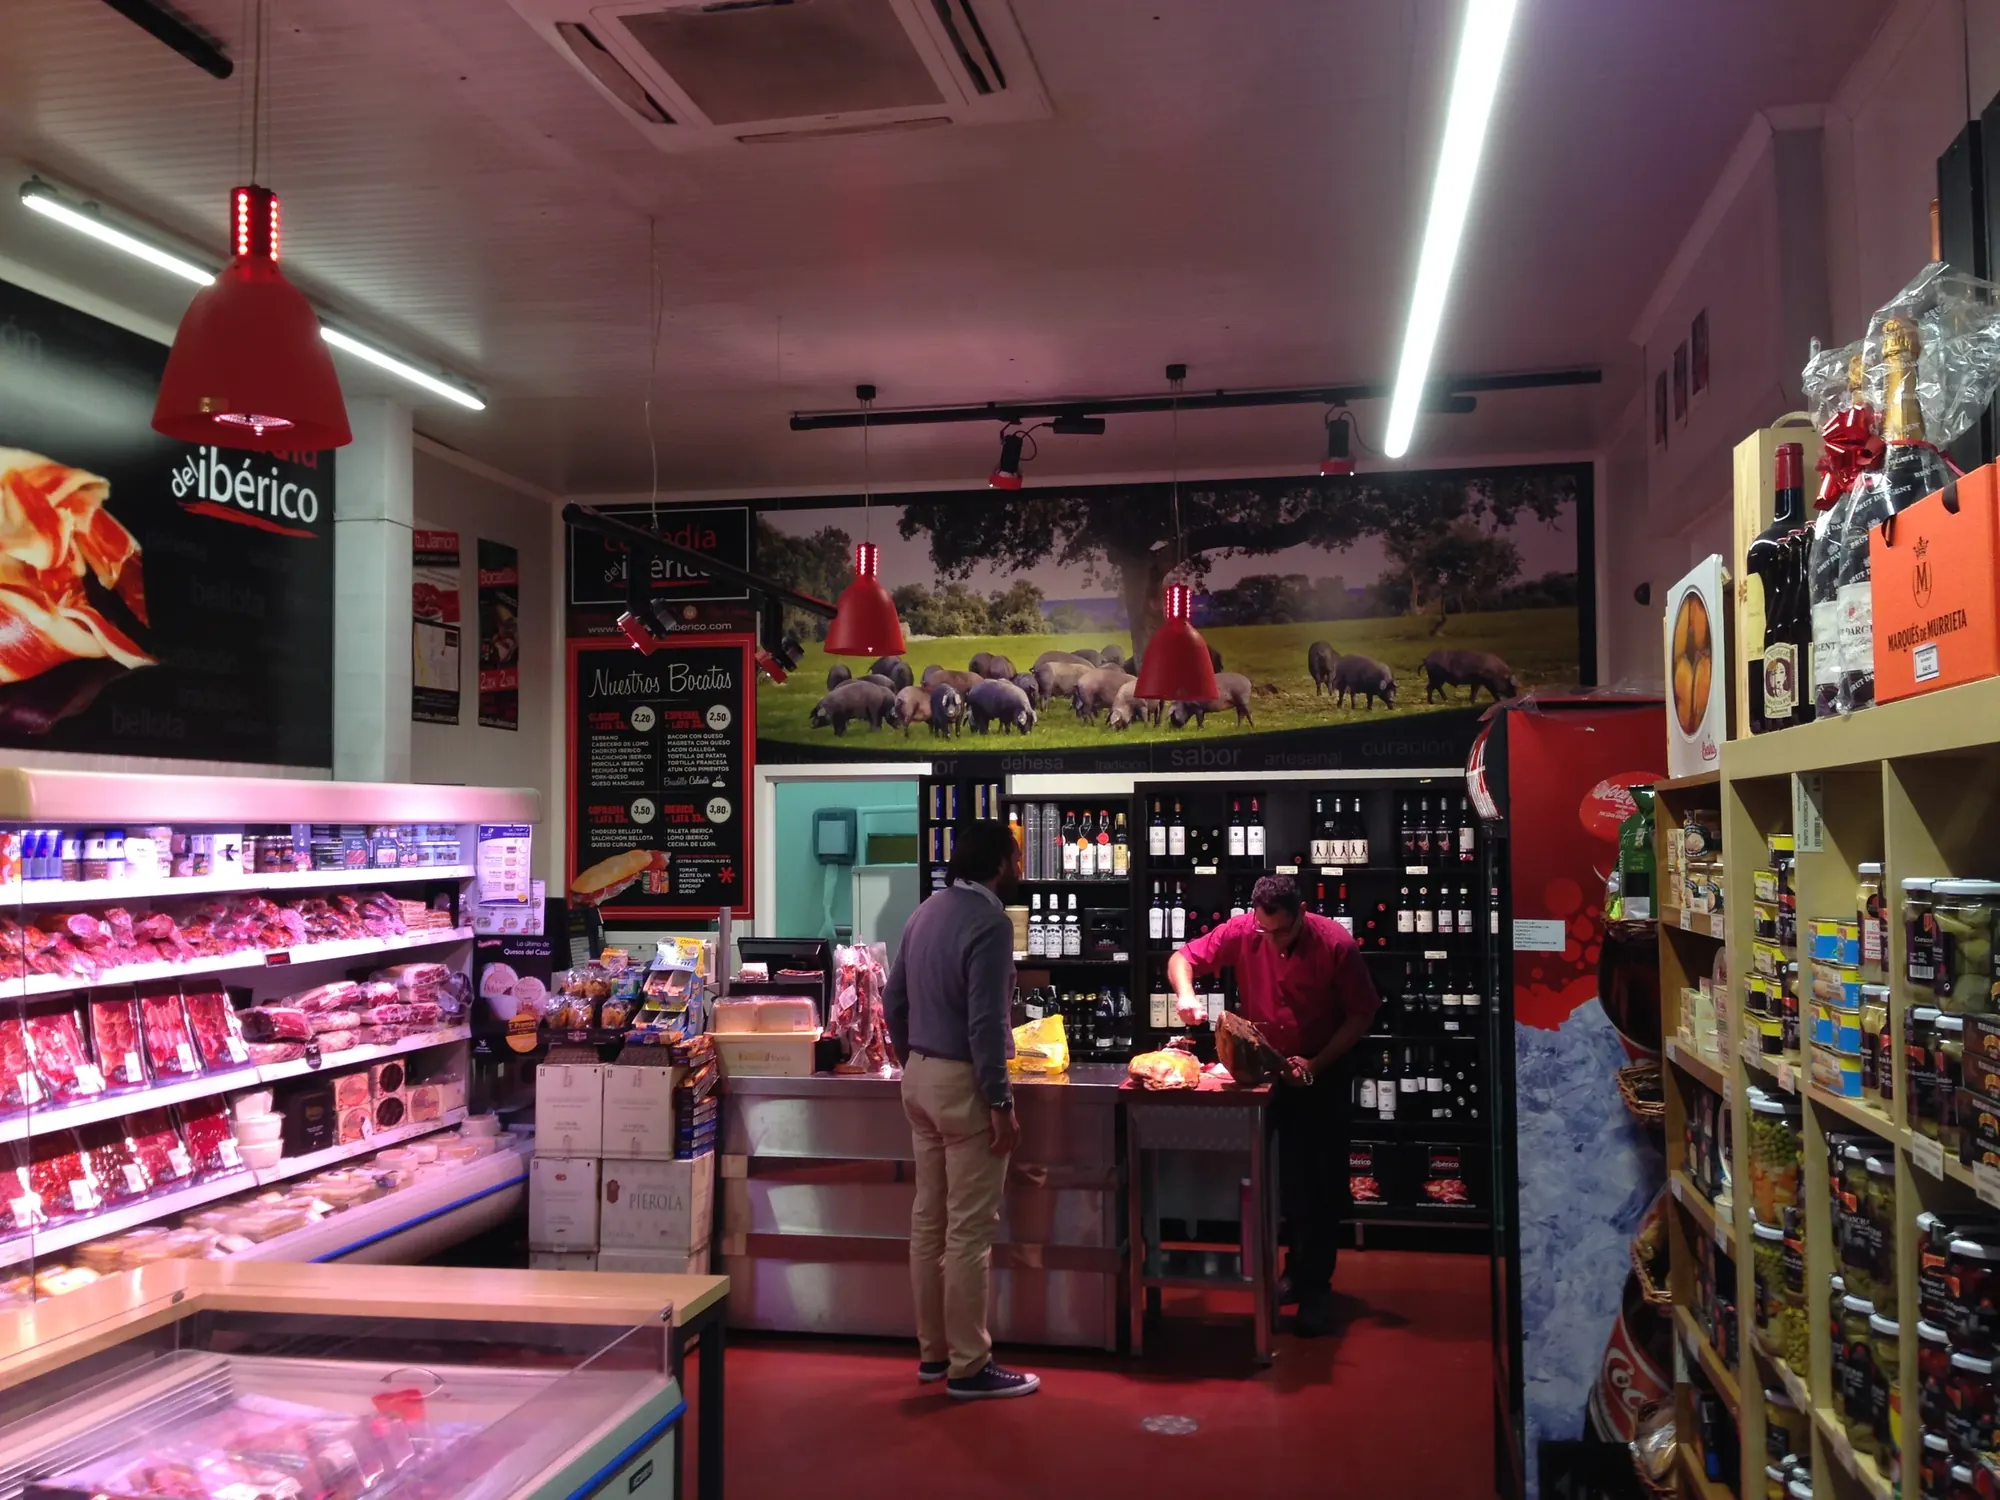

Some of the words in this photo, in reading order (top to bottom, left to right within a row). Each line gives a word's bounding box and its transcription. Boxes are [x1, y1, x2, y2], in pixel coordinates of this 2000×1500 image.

[171, 454, 199, 498] del
[198, 445, 318, 523] ibérico
[1916, 562, 1928, 595] M
[1888, 623, 1919, 653] MARQUÉS
[1927, 608, 1967, 639] MURRIETA
[588, 669, 660, 698] Nuestros
[668, 663, 732, 692] Bocatas
[1001, 753, 1064, 771] dehesa
[1171, 744, 1241, 767] sabor
[1264, 750, 1342, 766] artesanal
